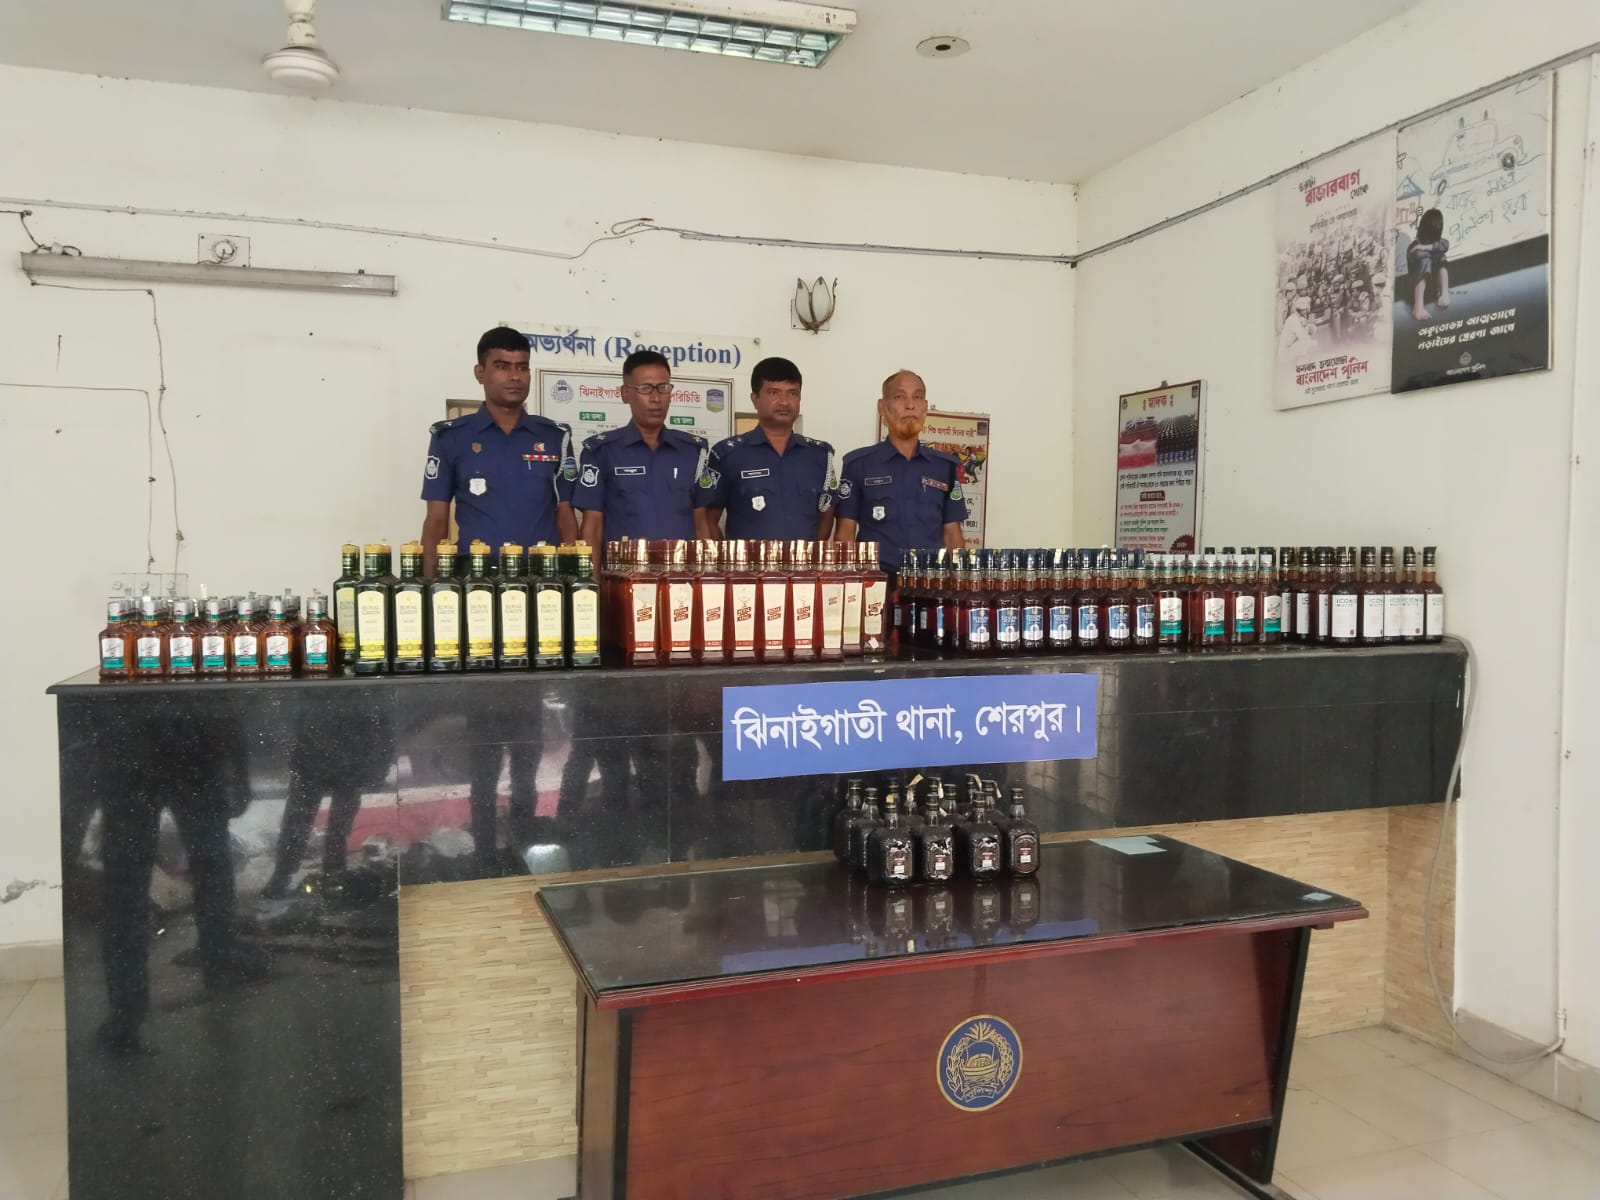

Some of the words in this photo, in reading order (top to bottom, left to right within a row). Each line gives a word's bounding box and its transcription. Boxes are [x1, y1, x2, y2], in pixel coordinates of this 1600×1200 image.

[1304, 169, 1361, 207] রাজারবাগ
[1296, 367, 1338, 386] বাংলাদেশ
[1341, 356, 1369, 379] পুলিশ
[731, 699, 888, 751] ঝিনাইগাতী
[896, 704, 963, 745] থানা,
[975, 700, 1068, 742] শেরপুর
